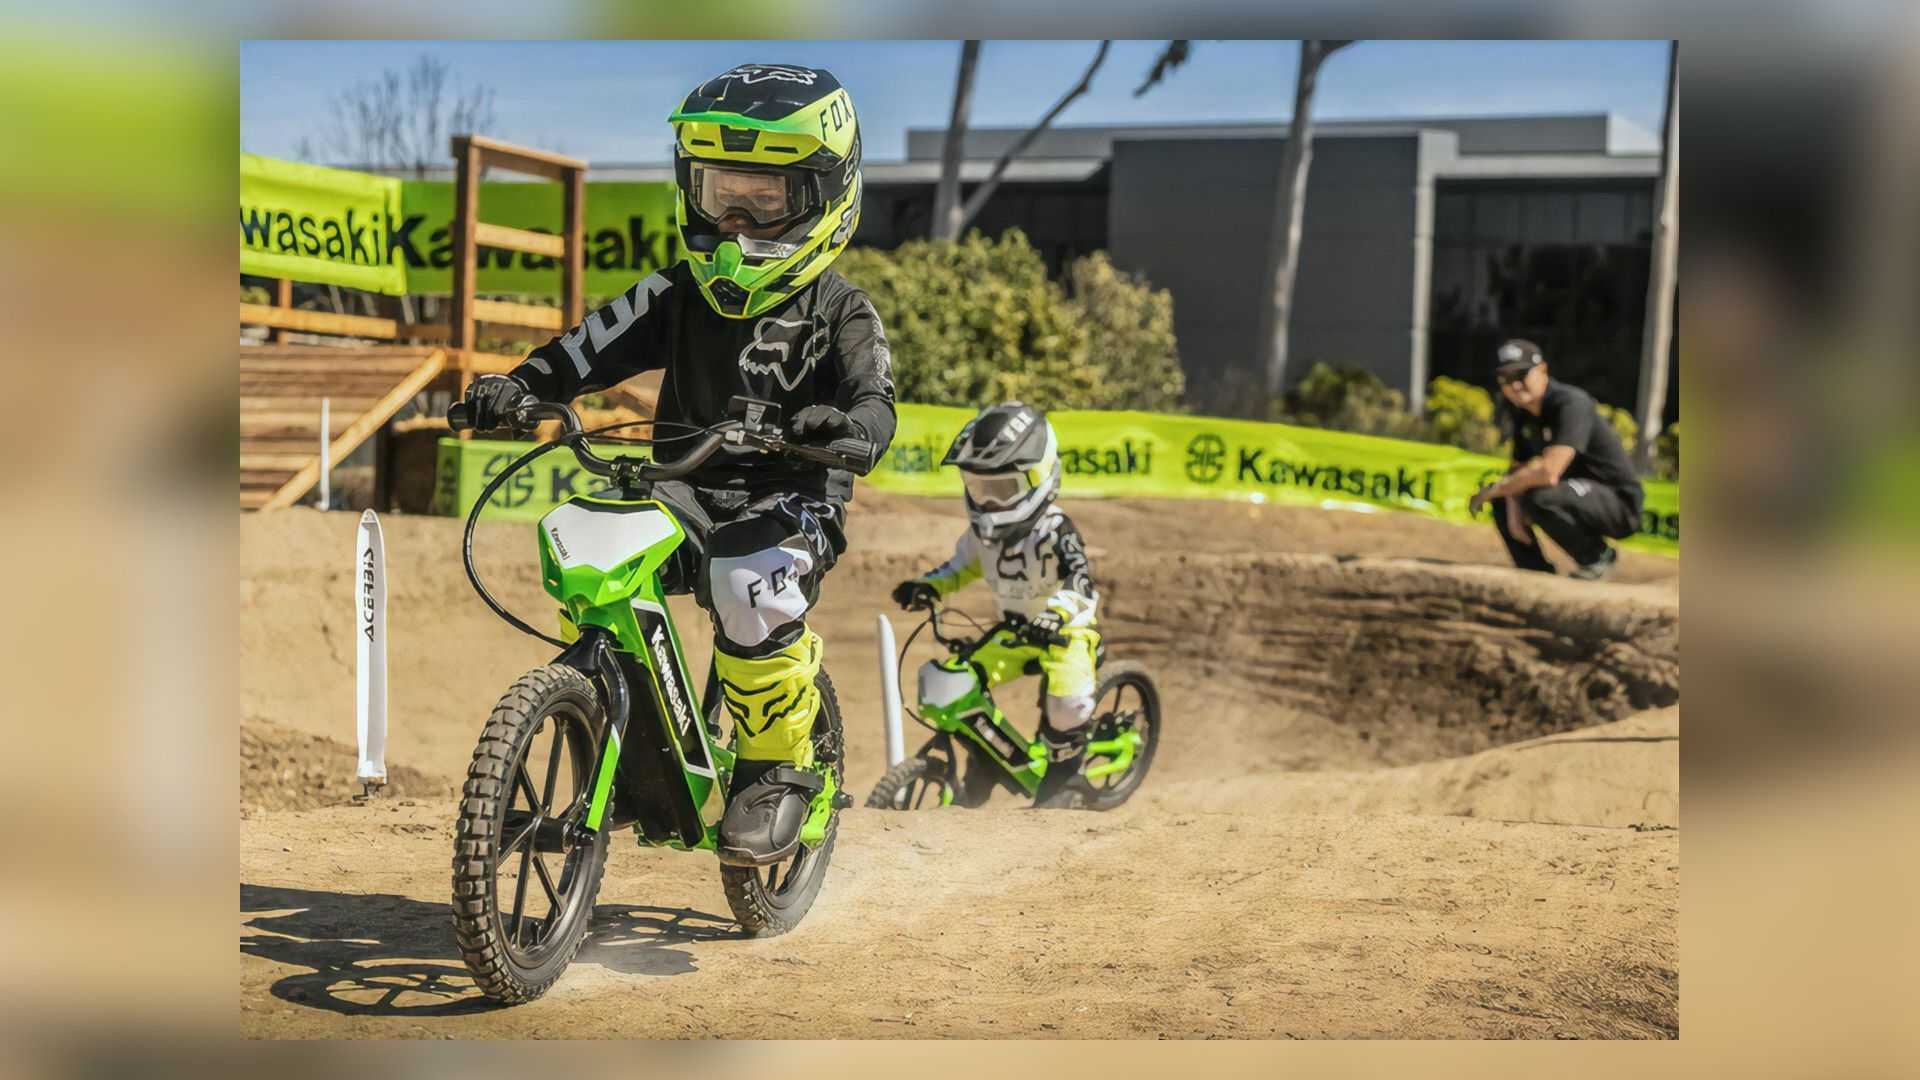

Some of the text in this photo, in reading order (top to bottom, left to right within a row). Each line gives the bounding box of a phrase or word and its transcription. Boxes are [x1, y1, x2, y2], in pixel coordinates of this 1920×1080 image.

[819, 91, 852, 142] FOX
[1057, 442, 1153, 474] asaki
[1238, 447, 1434, 501] Kawasaki
[363, 547, 375, 643] ACERBIS
[651, 624, 691, 737] Kawasaki
